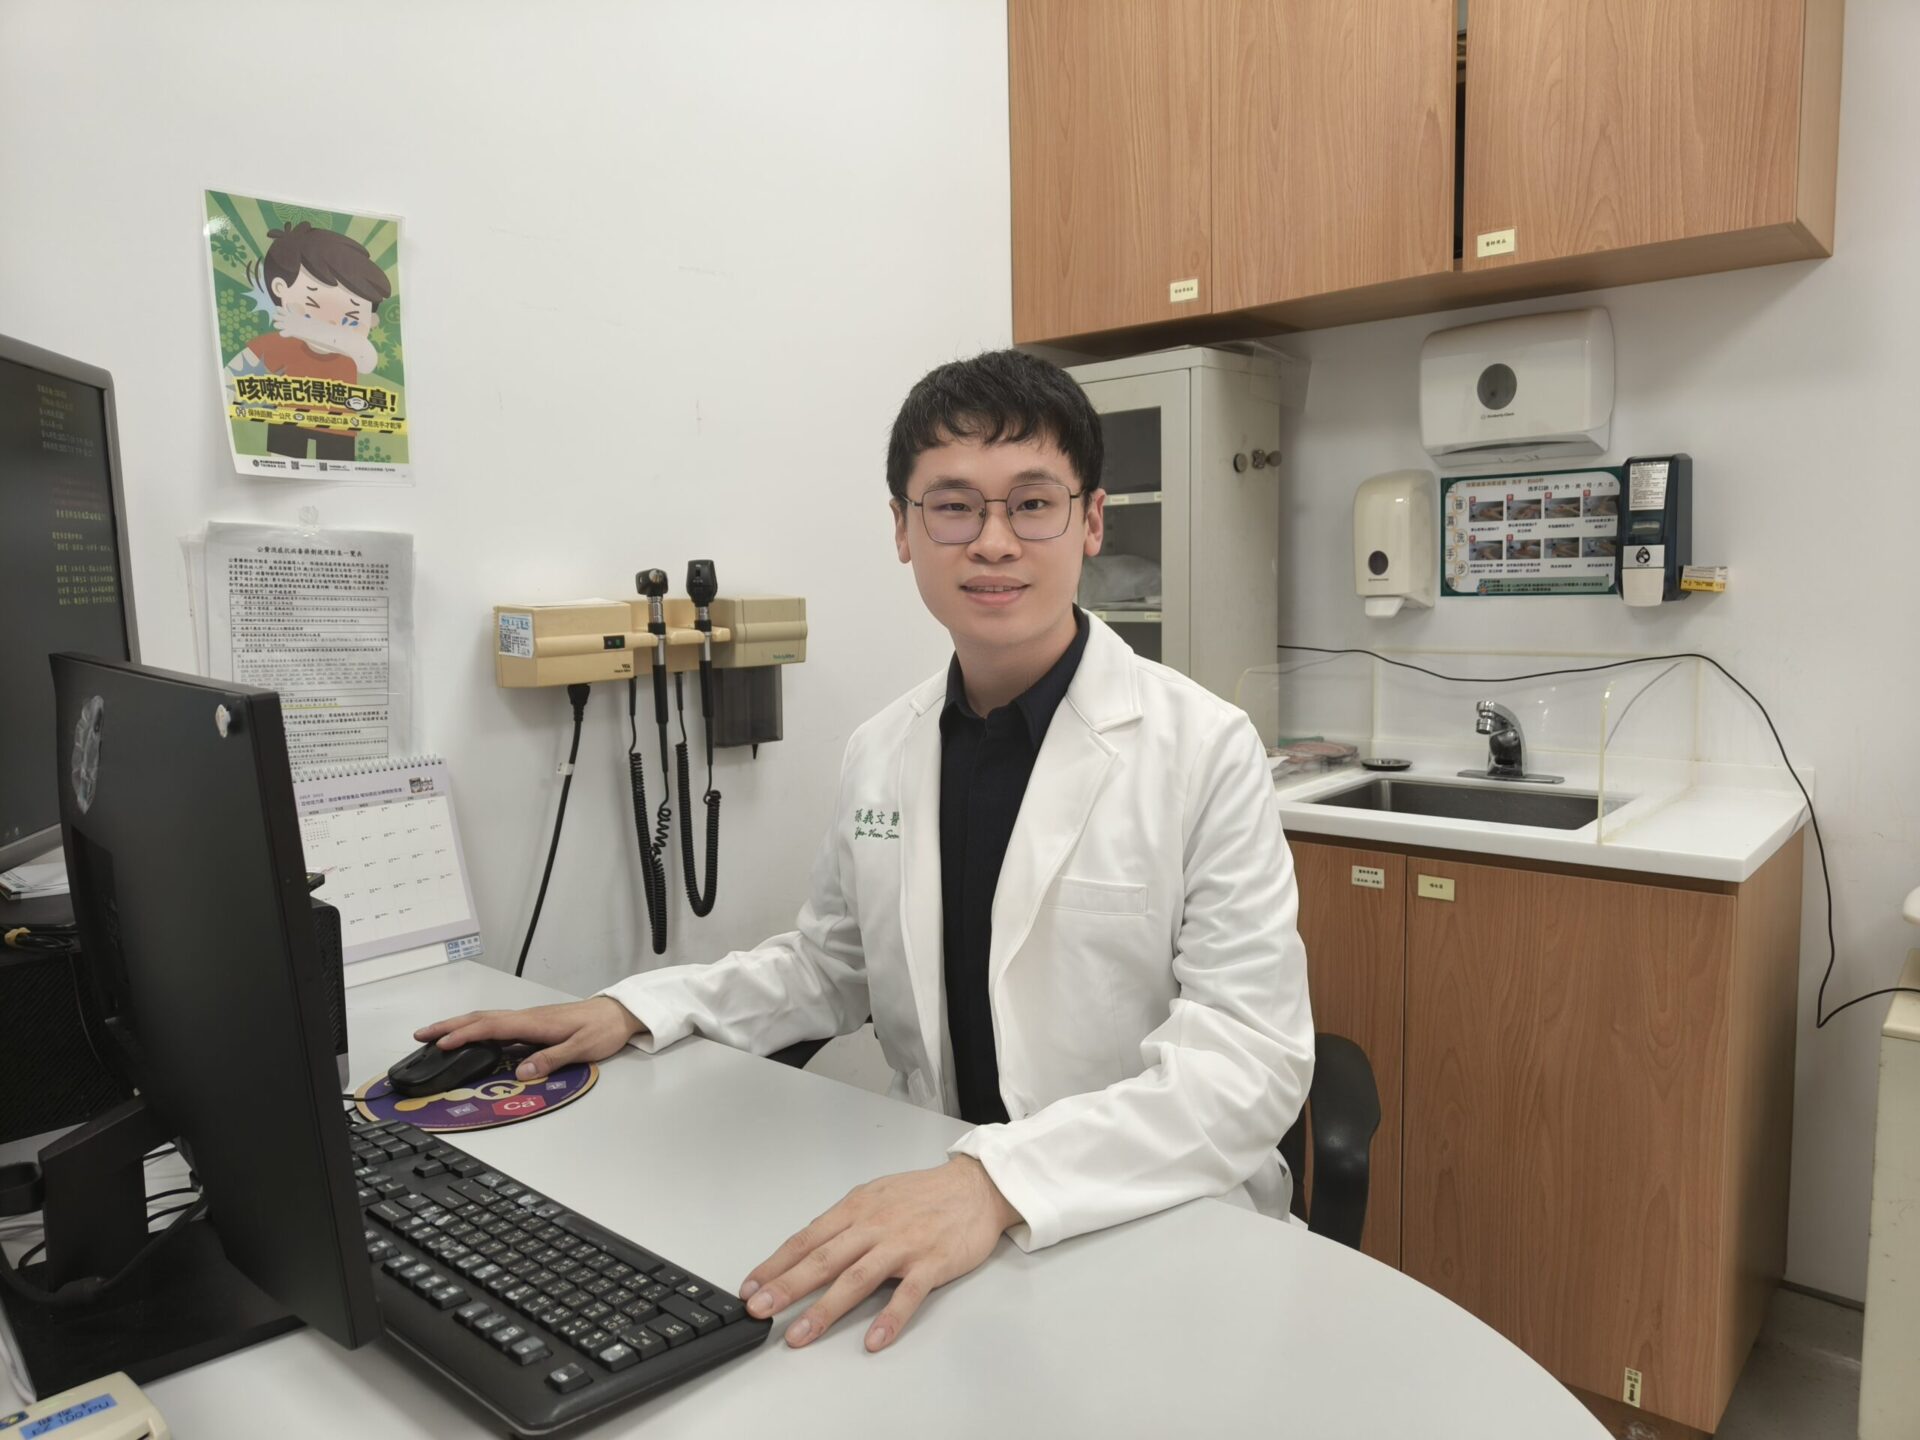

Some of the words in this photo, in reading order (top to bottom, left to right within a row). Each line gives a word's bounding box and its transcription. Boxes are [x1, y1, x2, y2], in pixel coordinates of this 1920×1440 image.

[236, 376, 397, 412] 咳嗽記得遮口鼻!
[503, 1099, 536, 1111] Ca
